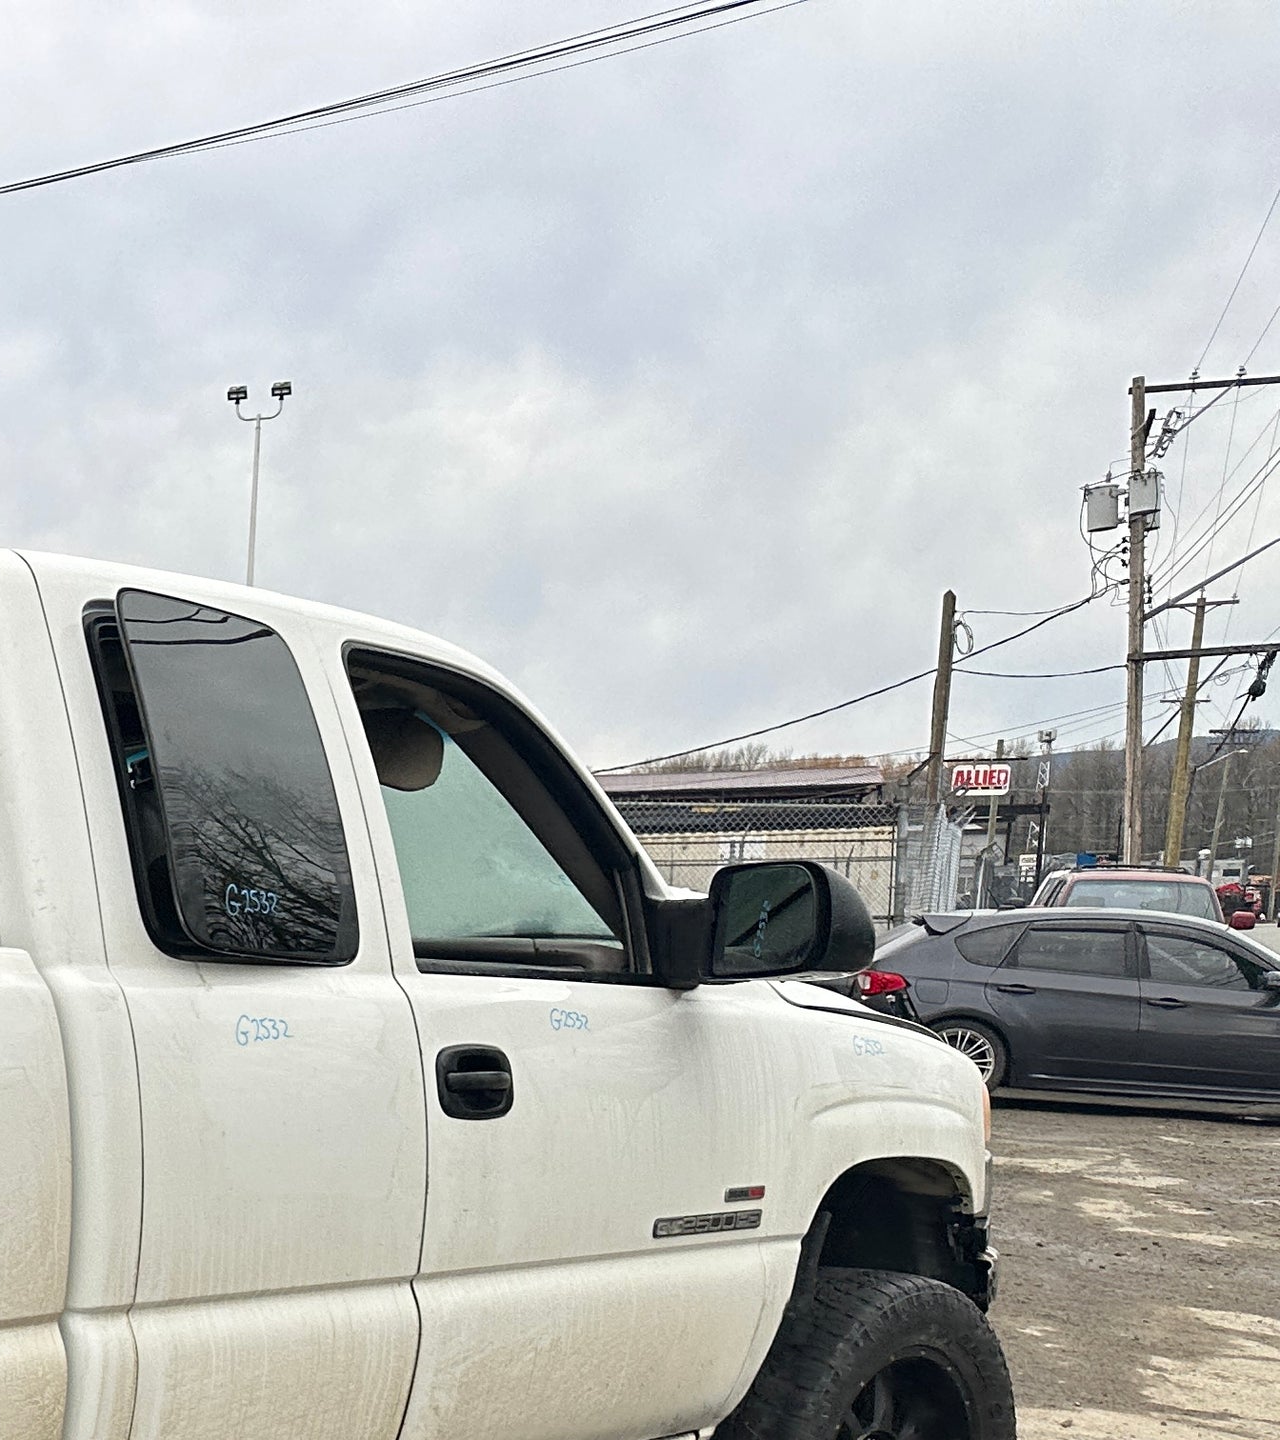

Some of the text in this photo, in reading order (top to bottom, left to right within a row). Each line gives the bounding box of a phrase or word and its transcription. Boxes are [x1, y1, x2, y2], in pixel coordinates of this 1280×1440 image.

[225, 883, 278, 916] G2532
[236, 1014, 294, 1046] G2532
[550, 1008, 590, 1031] G2532
